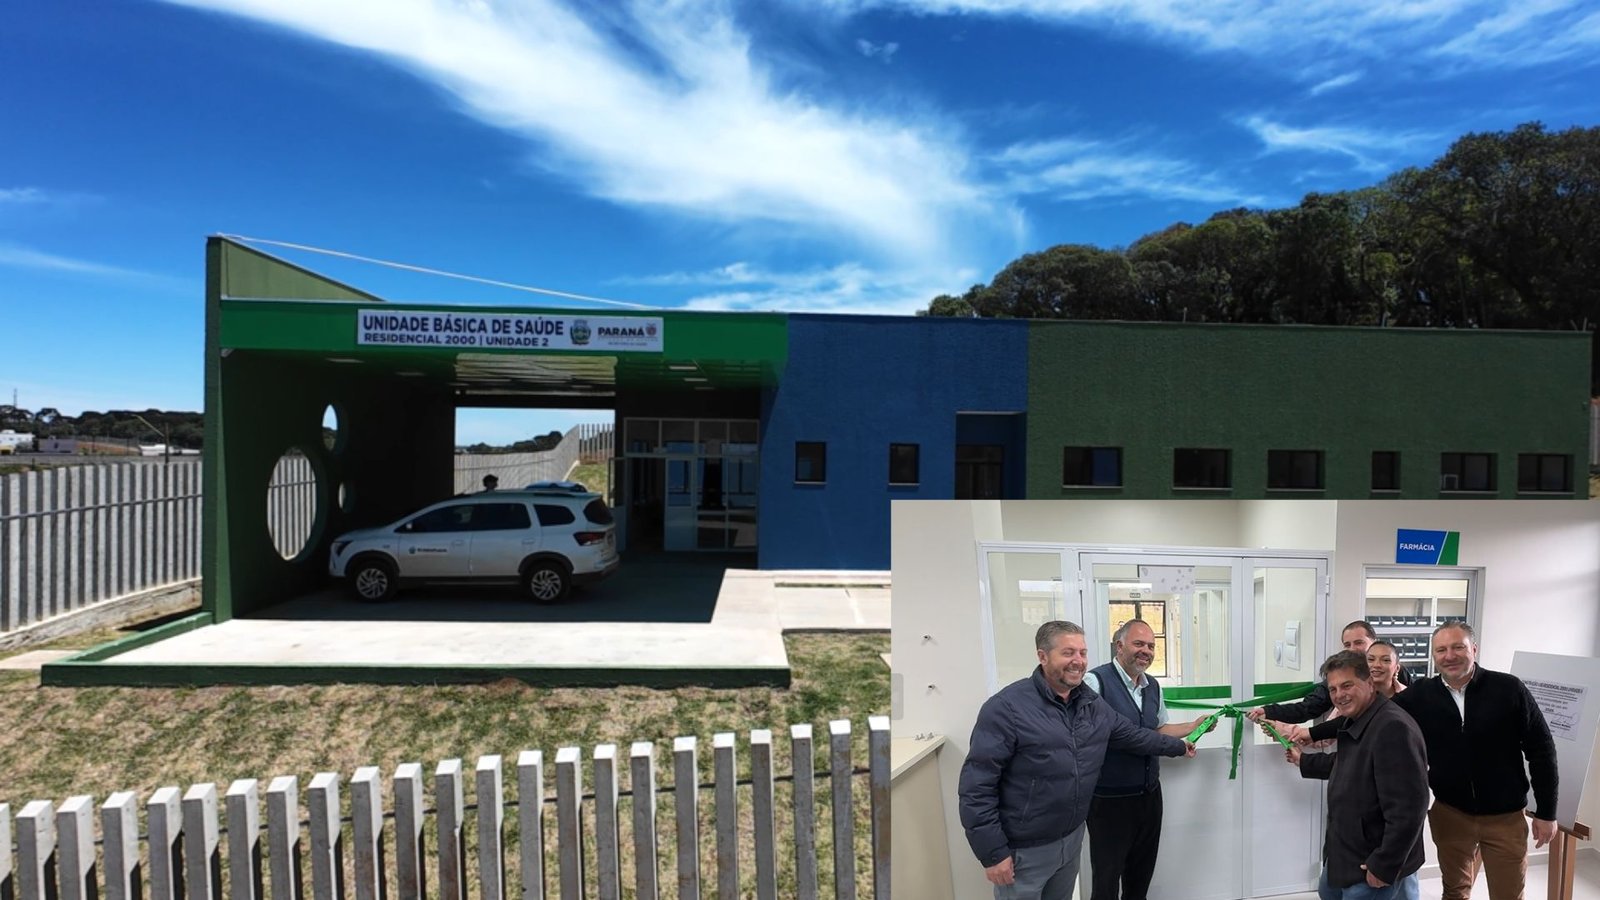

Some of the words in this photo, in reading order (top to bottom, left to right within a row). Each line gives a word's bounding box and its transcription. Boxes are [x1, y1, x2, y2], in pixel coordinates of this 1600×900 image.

[363, 315, 429, 332] UNIDADE
[433, 314, 487, 334] BÁSICA
[492, 319, 511, 334] DE
[515, 316, 564, 335] SAÚDE
[598, 326, 644, 336] PARANÁ
[364, 332, 442, 344] RESIDENCIAL
[445, 335, 476, 345] 2000
[486, 336, 539, 346] UNIDADE
[542, 337, 549, 347] 2
[1400, 543, 1435, 551] FARMÁCIA
